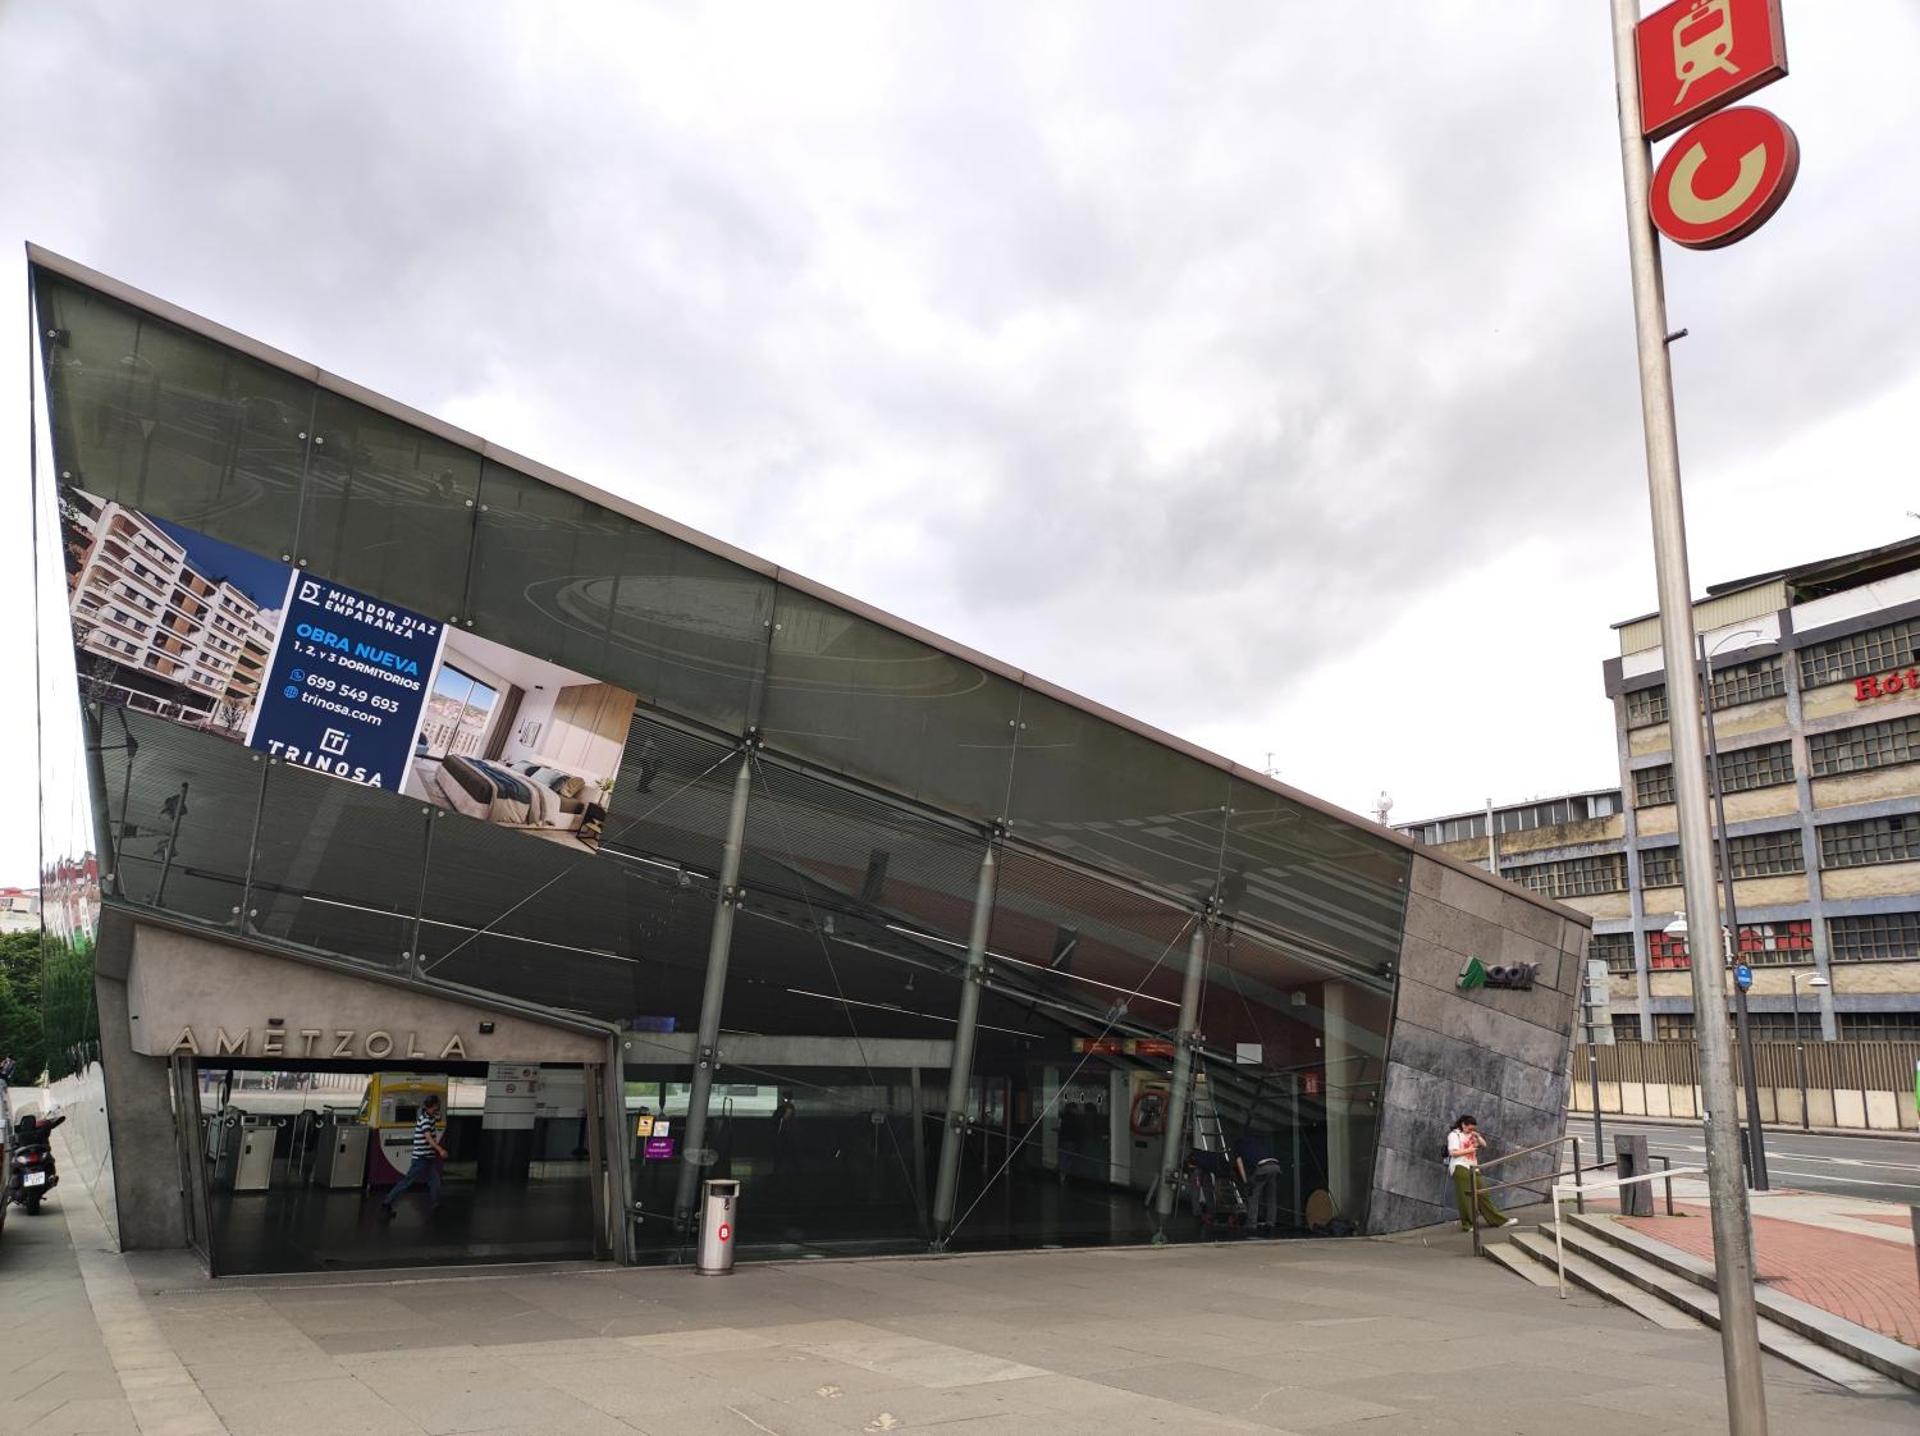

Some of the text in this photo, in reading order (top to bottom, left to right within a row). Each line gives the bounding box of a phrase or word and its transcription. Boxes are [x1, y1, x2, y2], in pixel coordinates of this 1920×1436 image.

[324, 600, 413, 640] EMPARANZA
[329, 589, 396, 621] MIRADOR
[402, 616, 437, 636] DIAZ
[296, 623, 419, 676] OBRA NUEVA
[327, 653, 336, 663] 3
[338, 655, 421, 691] DORMITORIOS
[301, 691, 382, 727] trinosa.com
[306, 673, 399, 713] 699 549 693
[268, 739, 383, 788] TRINOSA
[167, 1025, 468, 1060] AMETZOLA
